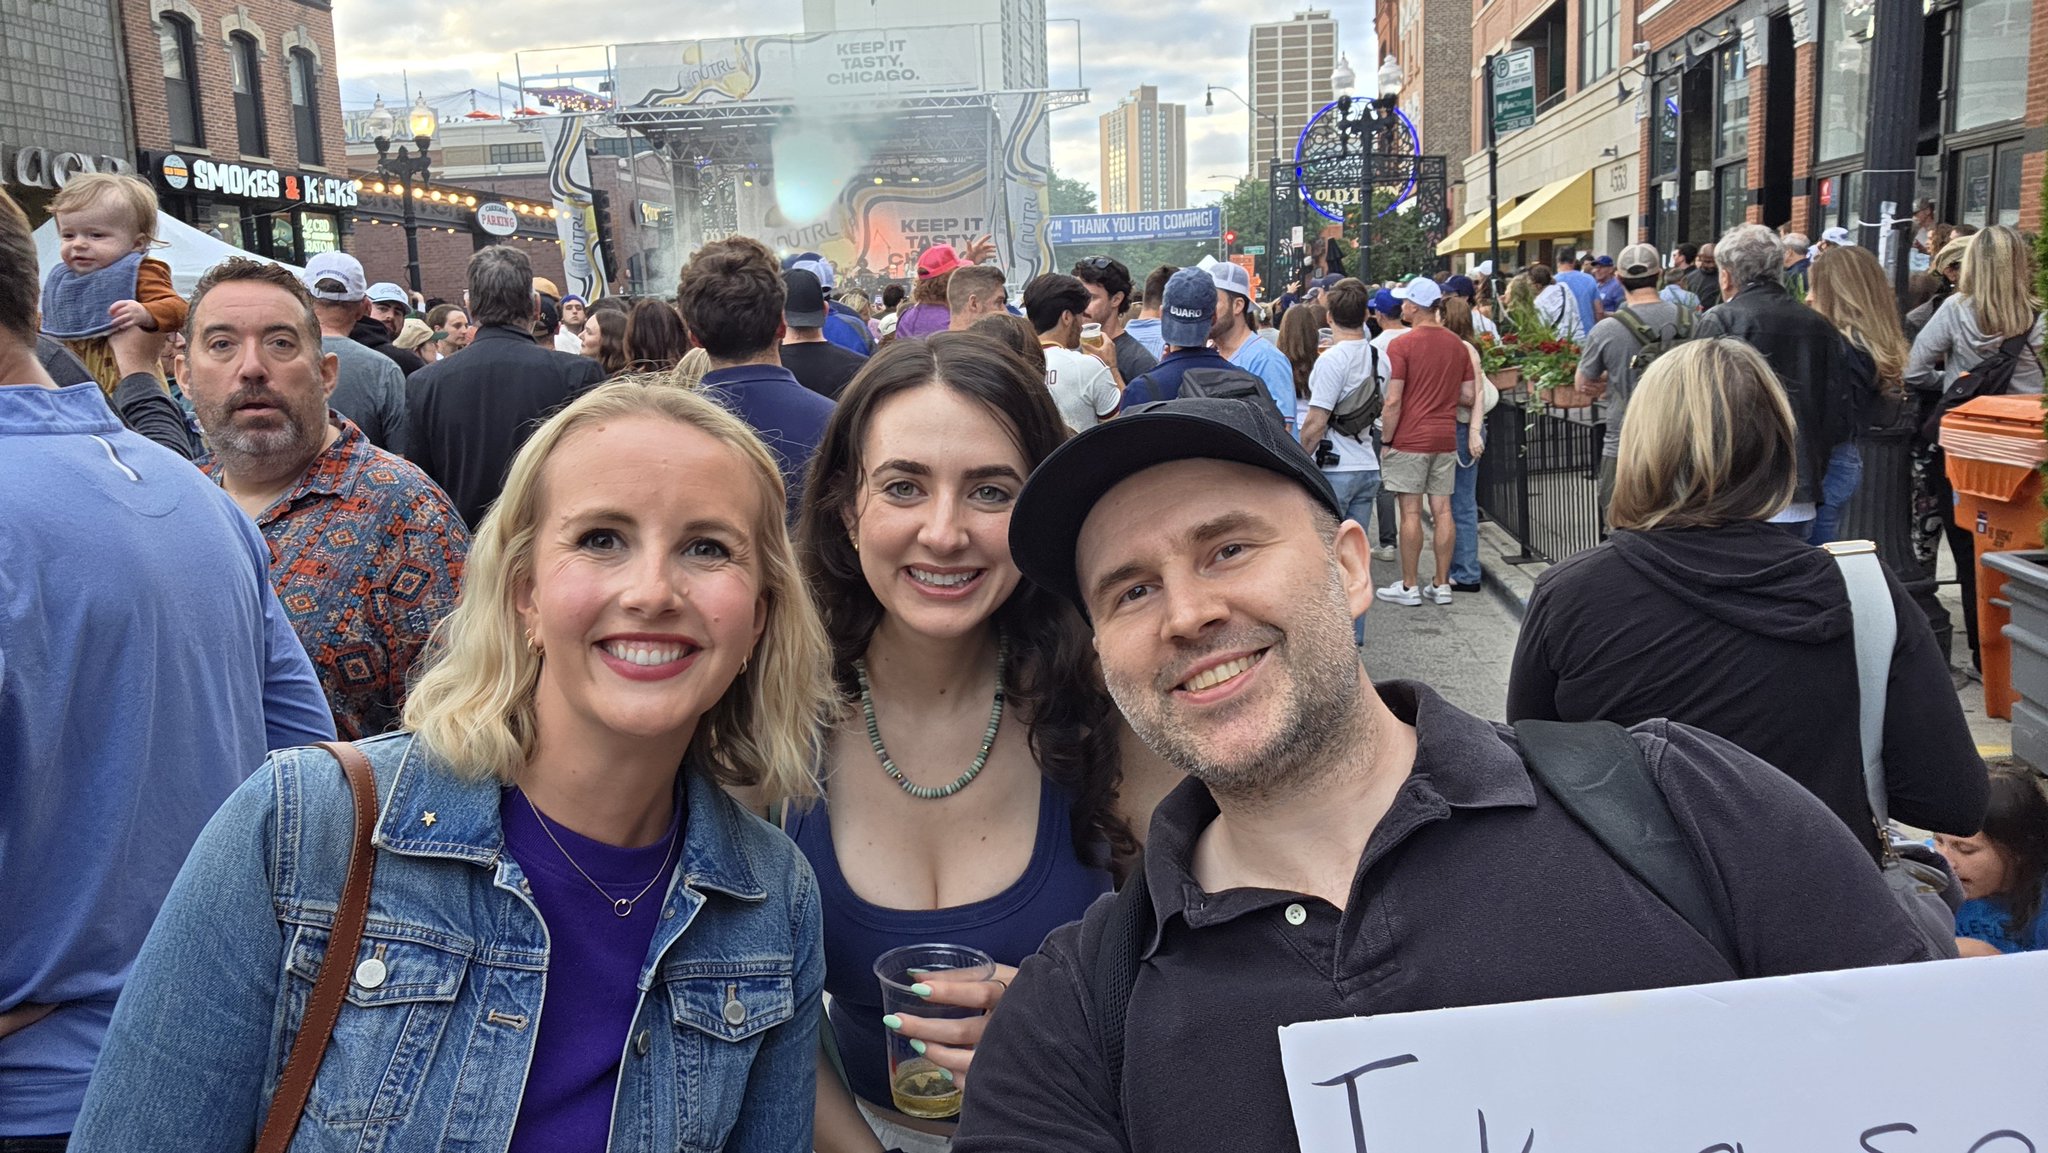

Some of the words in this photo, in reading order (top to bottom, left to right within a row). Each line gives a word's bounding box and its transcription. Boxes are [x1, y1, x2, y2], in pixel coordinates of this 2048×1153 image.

[836, 41, 885, 56] KEEP
[889, 39, 907, 52] IT
[840, 54, 904, 70] TASTY,
[826, 69, 920, 85] CHICAGO.
[193, 159, 280, 198] SMOKES
[285, 175, 300, 200] &
[1315, 187, 1346, 205] OLD
[481, 214, 515, 228] PARKING
[901, 218, 959, 233] KEEP
[964, 217, 984, 231] IT
[1070, 218, 1110, 235] THANK
[1112, 216, 1136, 233] YOU
[1138, 215, 1161, 232] FOR
[1163, 210, 1213, 230] COMING!
